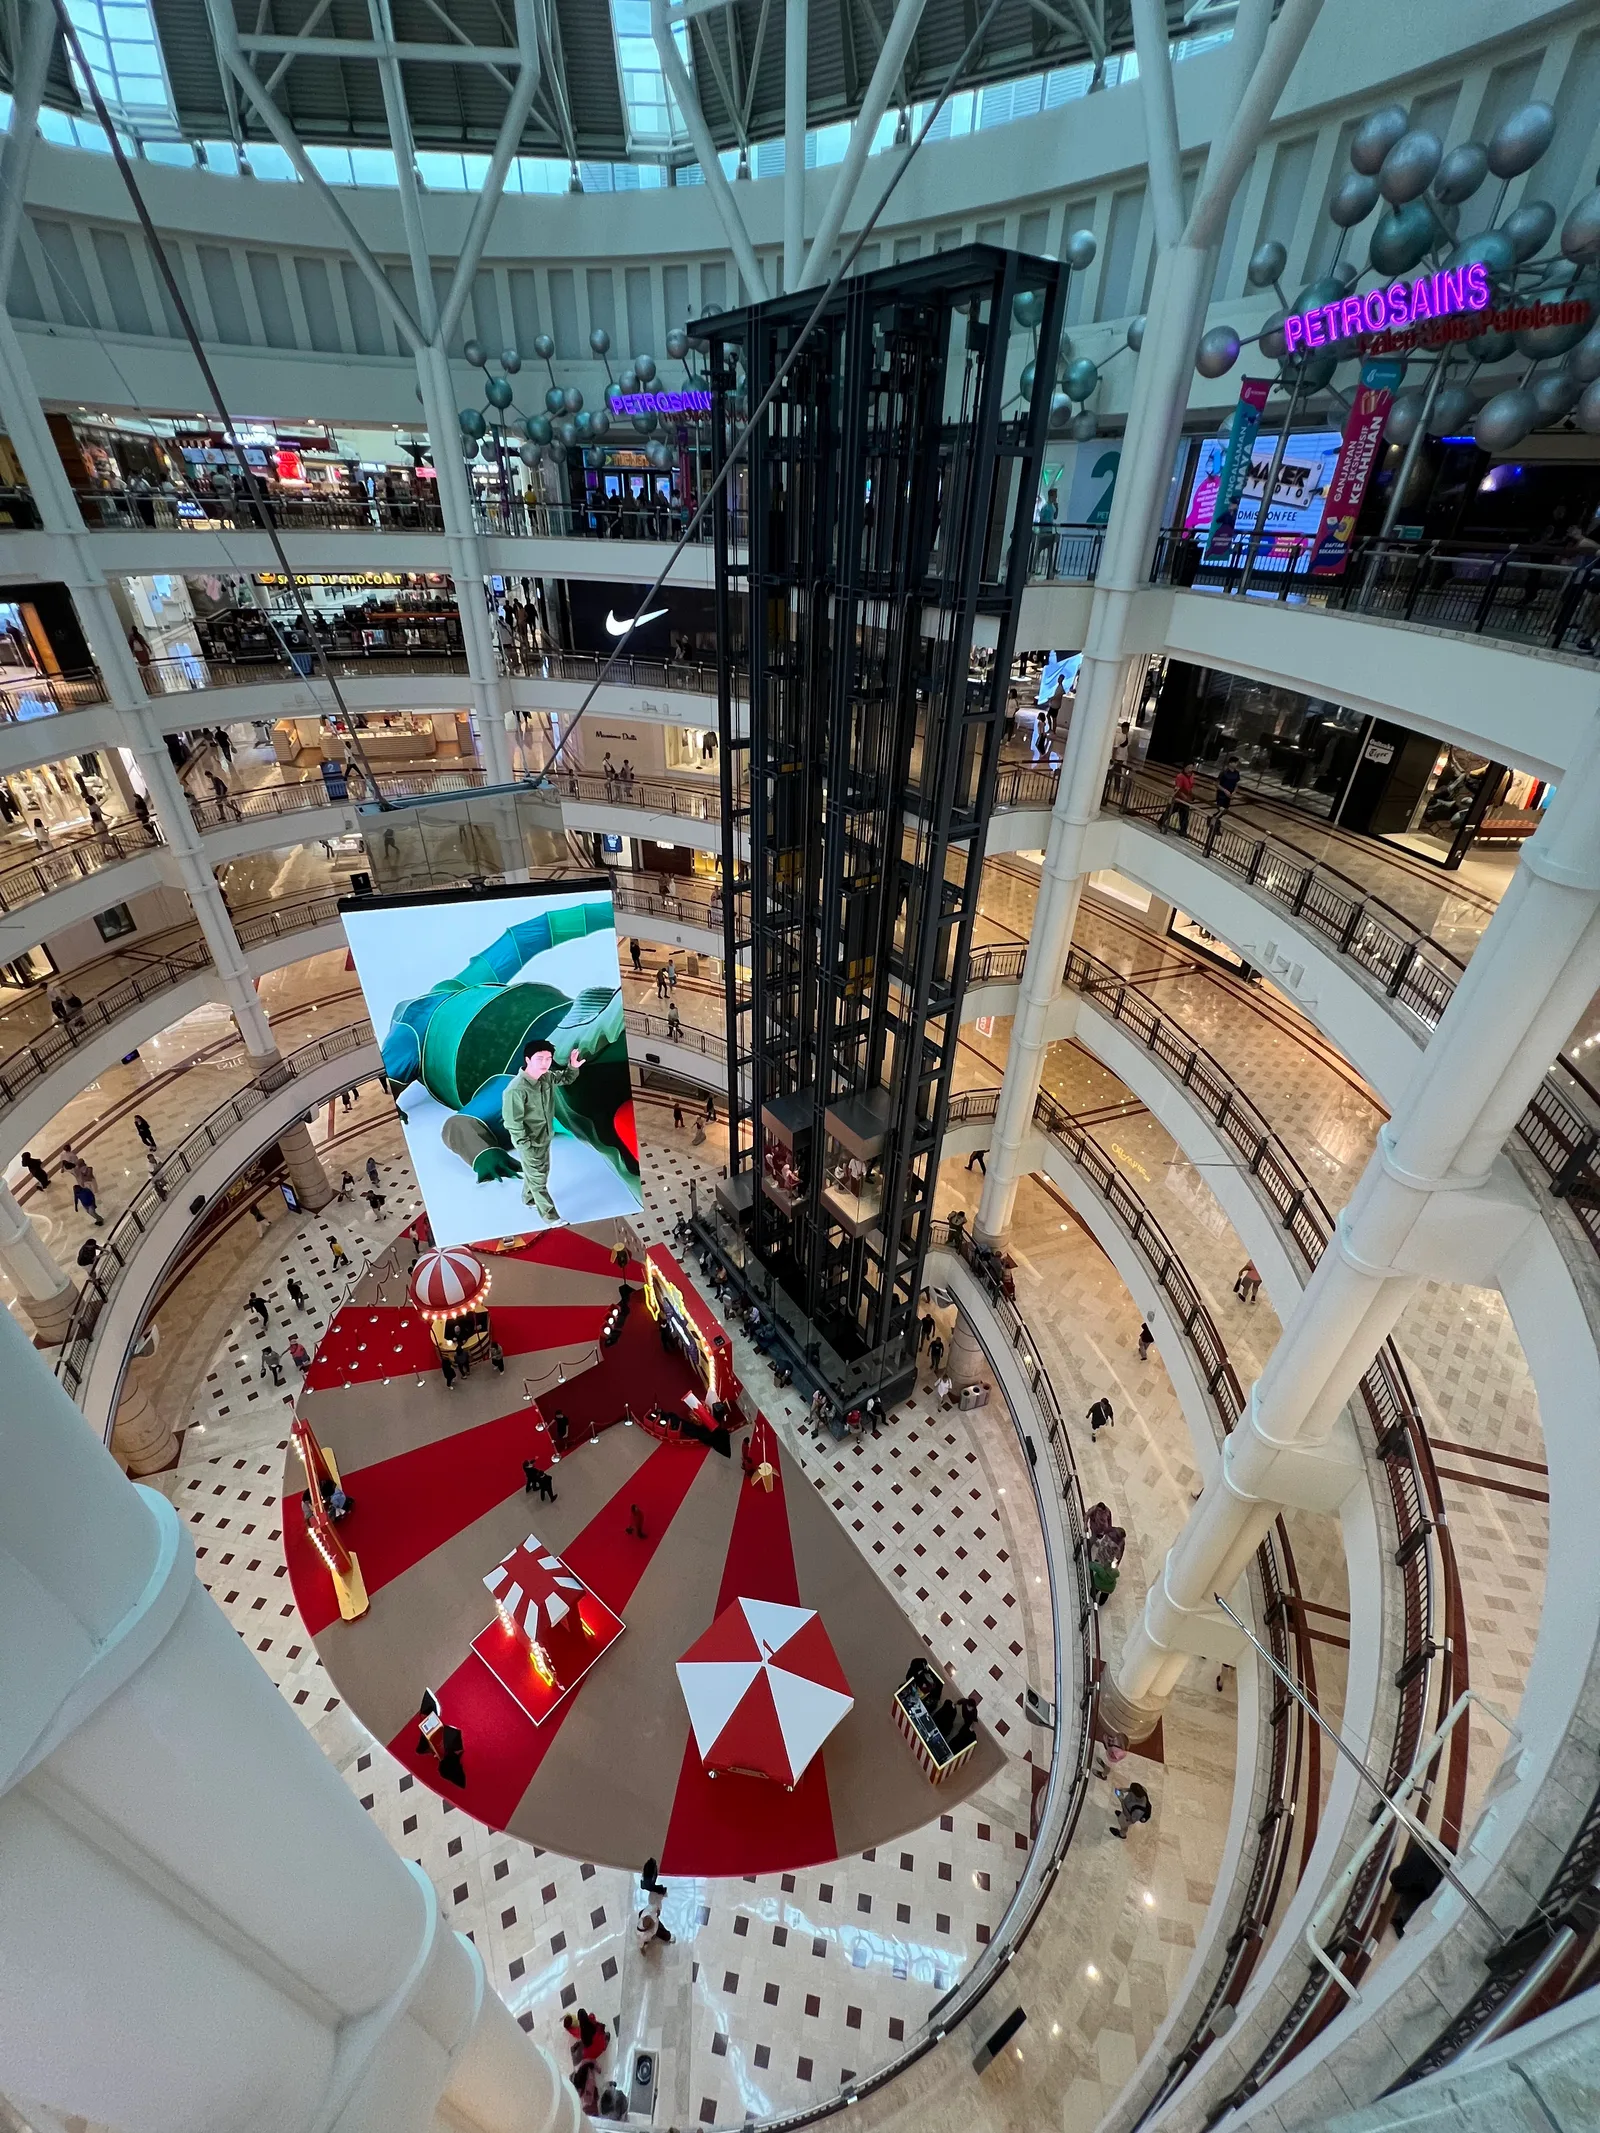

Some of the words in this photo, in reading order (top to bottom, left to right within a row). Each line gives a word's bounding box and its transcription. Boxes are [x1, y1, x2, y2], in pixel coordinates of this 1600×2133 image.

[1284, 260, 1490, 352] PETROSAINS
[1480, 299, 1590, 337] Petroleum
[610, 390, 712, 416] PETROSAIN
[1224, 426, 1247, 504] PENGALAMAN
[1235, 443, 1253, 490] MAYA
[1334, 441, 1357, 502] GANJARAN
[1348, 425, 1369, 481] EKSKLUSIF
[1348, 416, 1383, 504] KEAHLIAN
[1237, 510, 1281, 521] DMISON
[1281, 511, 1298, 521] FEE
[320, 574, 335, 585] DU
[338, 574, 402, 585] CHOCOLAT
[291, 634, 299, 643] 3
[327, 763, 335, 773] 2
[358, 876, 364, 884] 1
